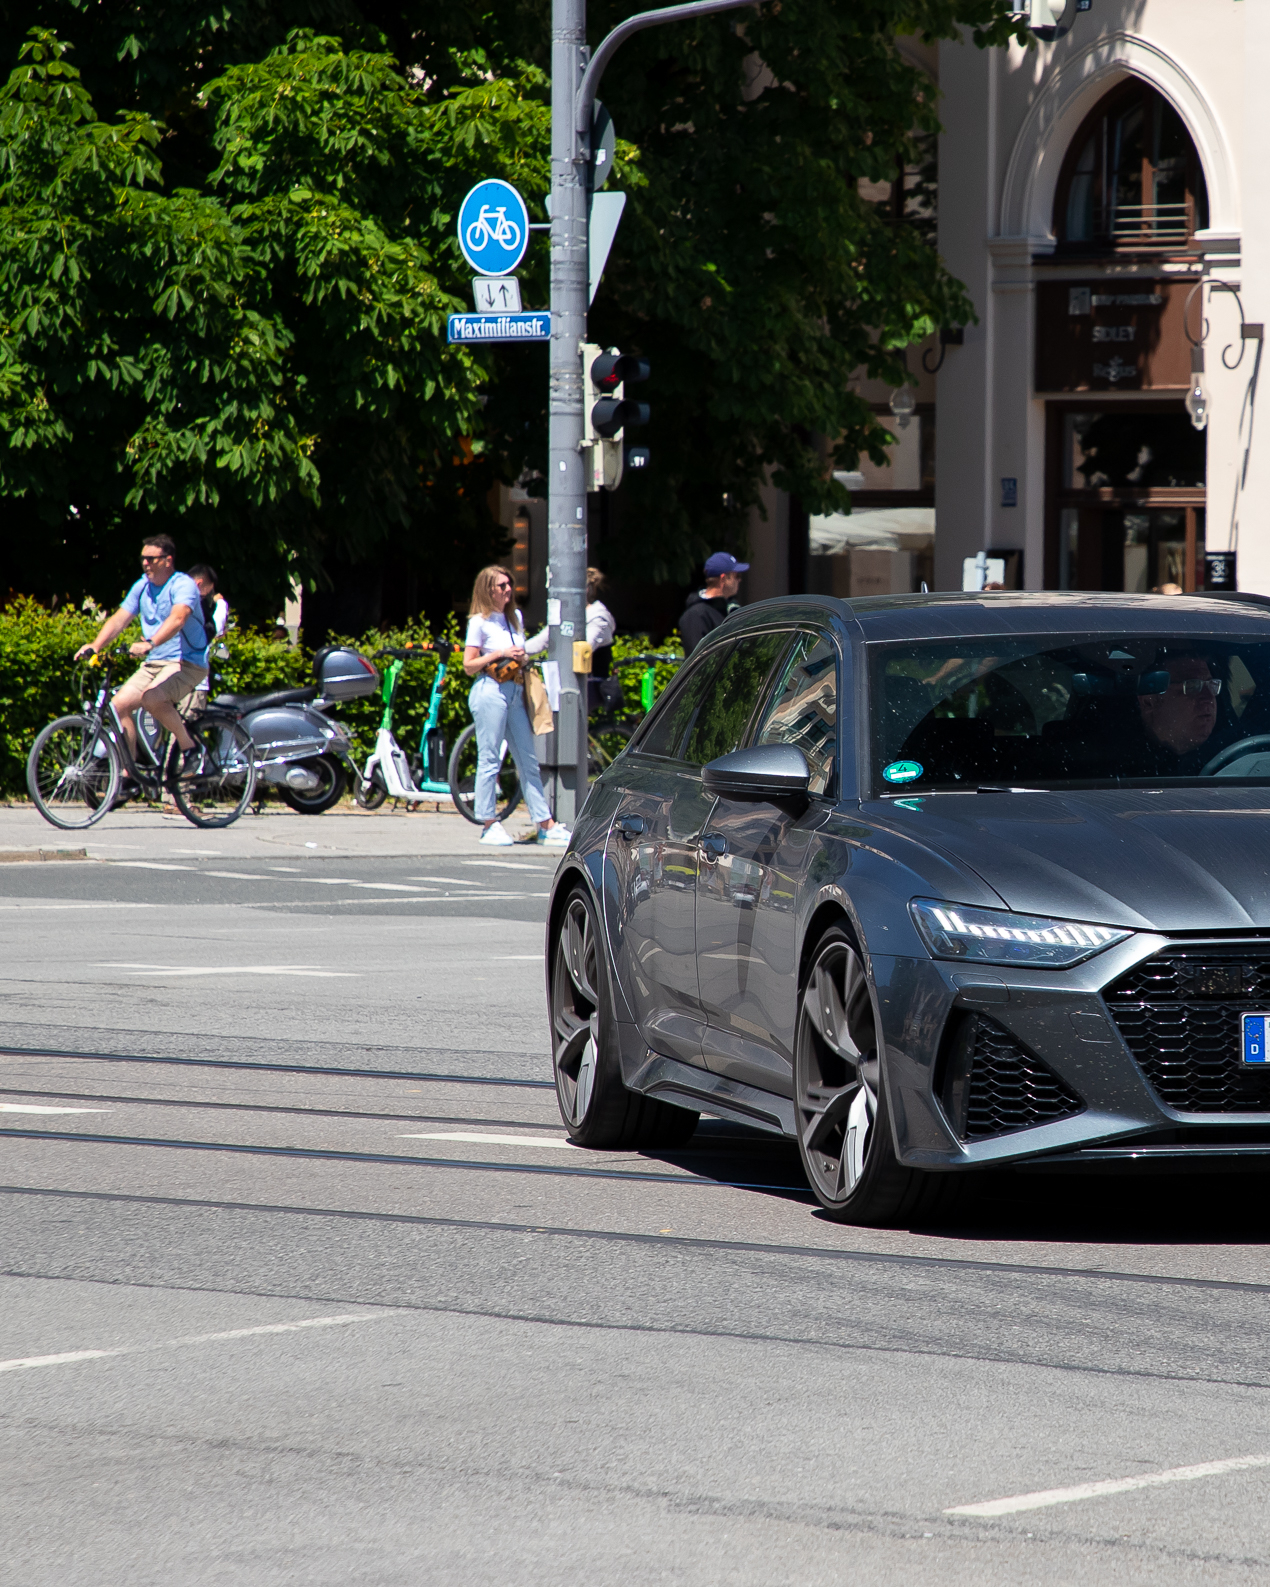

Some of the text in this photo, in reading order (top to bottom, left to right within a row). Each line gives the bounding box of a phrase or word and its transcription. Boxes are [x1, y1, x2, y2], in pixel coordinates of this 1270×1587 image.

[454, 318, 546, 339] Maximilianstr.
[1092, 325, 1137, 342] SIDLEY
[898, 764, 908, 772] 4
[1250, 1043, 1259, 1055] D
